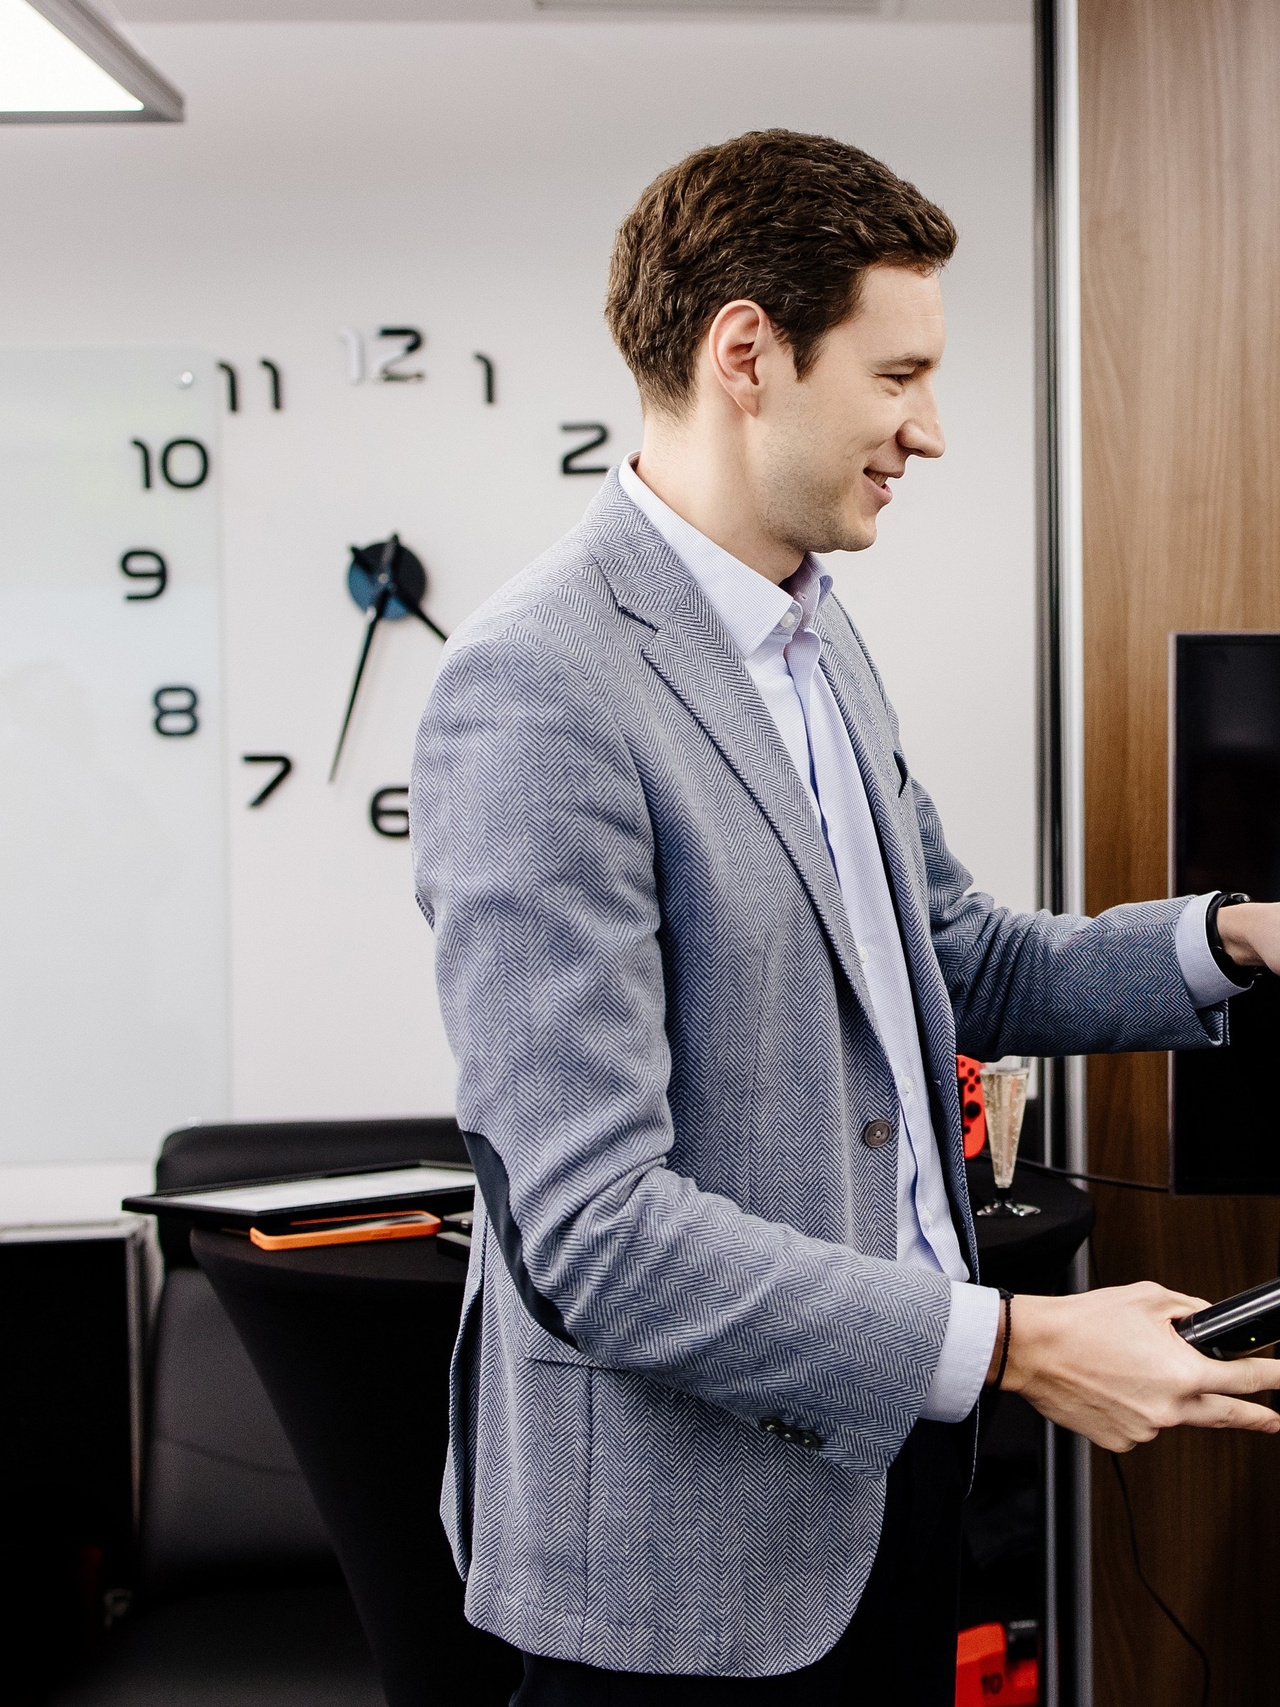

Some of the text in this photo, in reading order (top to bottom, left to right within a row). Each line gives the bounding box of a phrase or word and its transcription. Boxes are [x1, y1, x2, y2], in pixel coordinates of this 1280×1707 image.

[340, 325, 425, 384] 12
[473, 352, 495, 404] 1
[218, 358, 283, 413] 11
[131, 437, 211, 490] 10
[560, 422, 609, 476] 2
[120, 548, 169, 602] 9
[152, 686, 201, 738] 8
[243, 753, 294, 809] 7
[369, 786, 409, 839] 6
